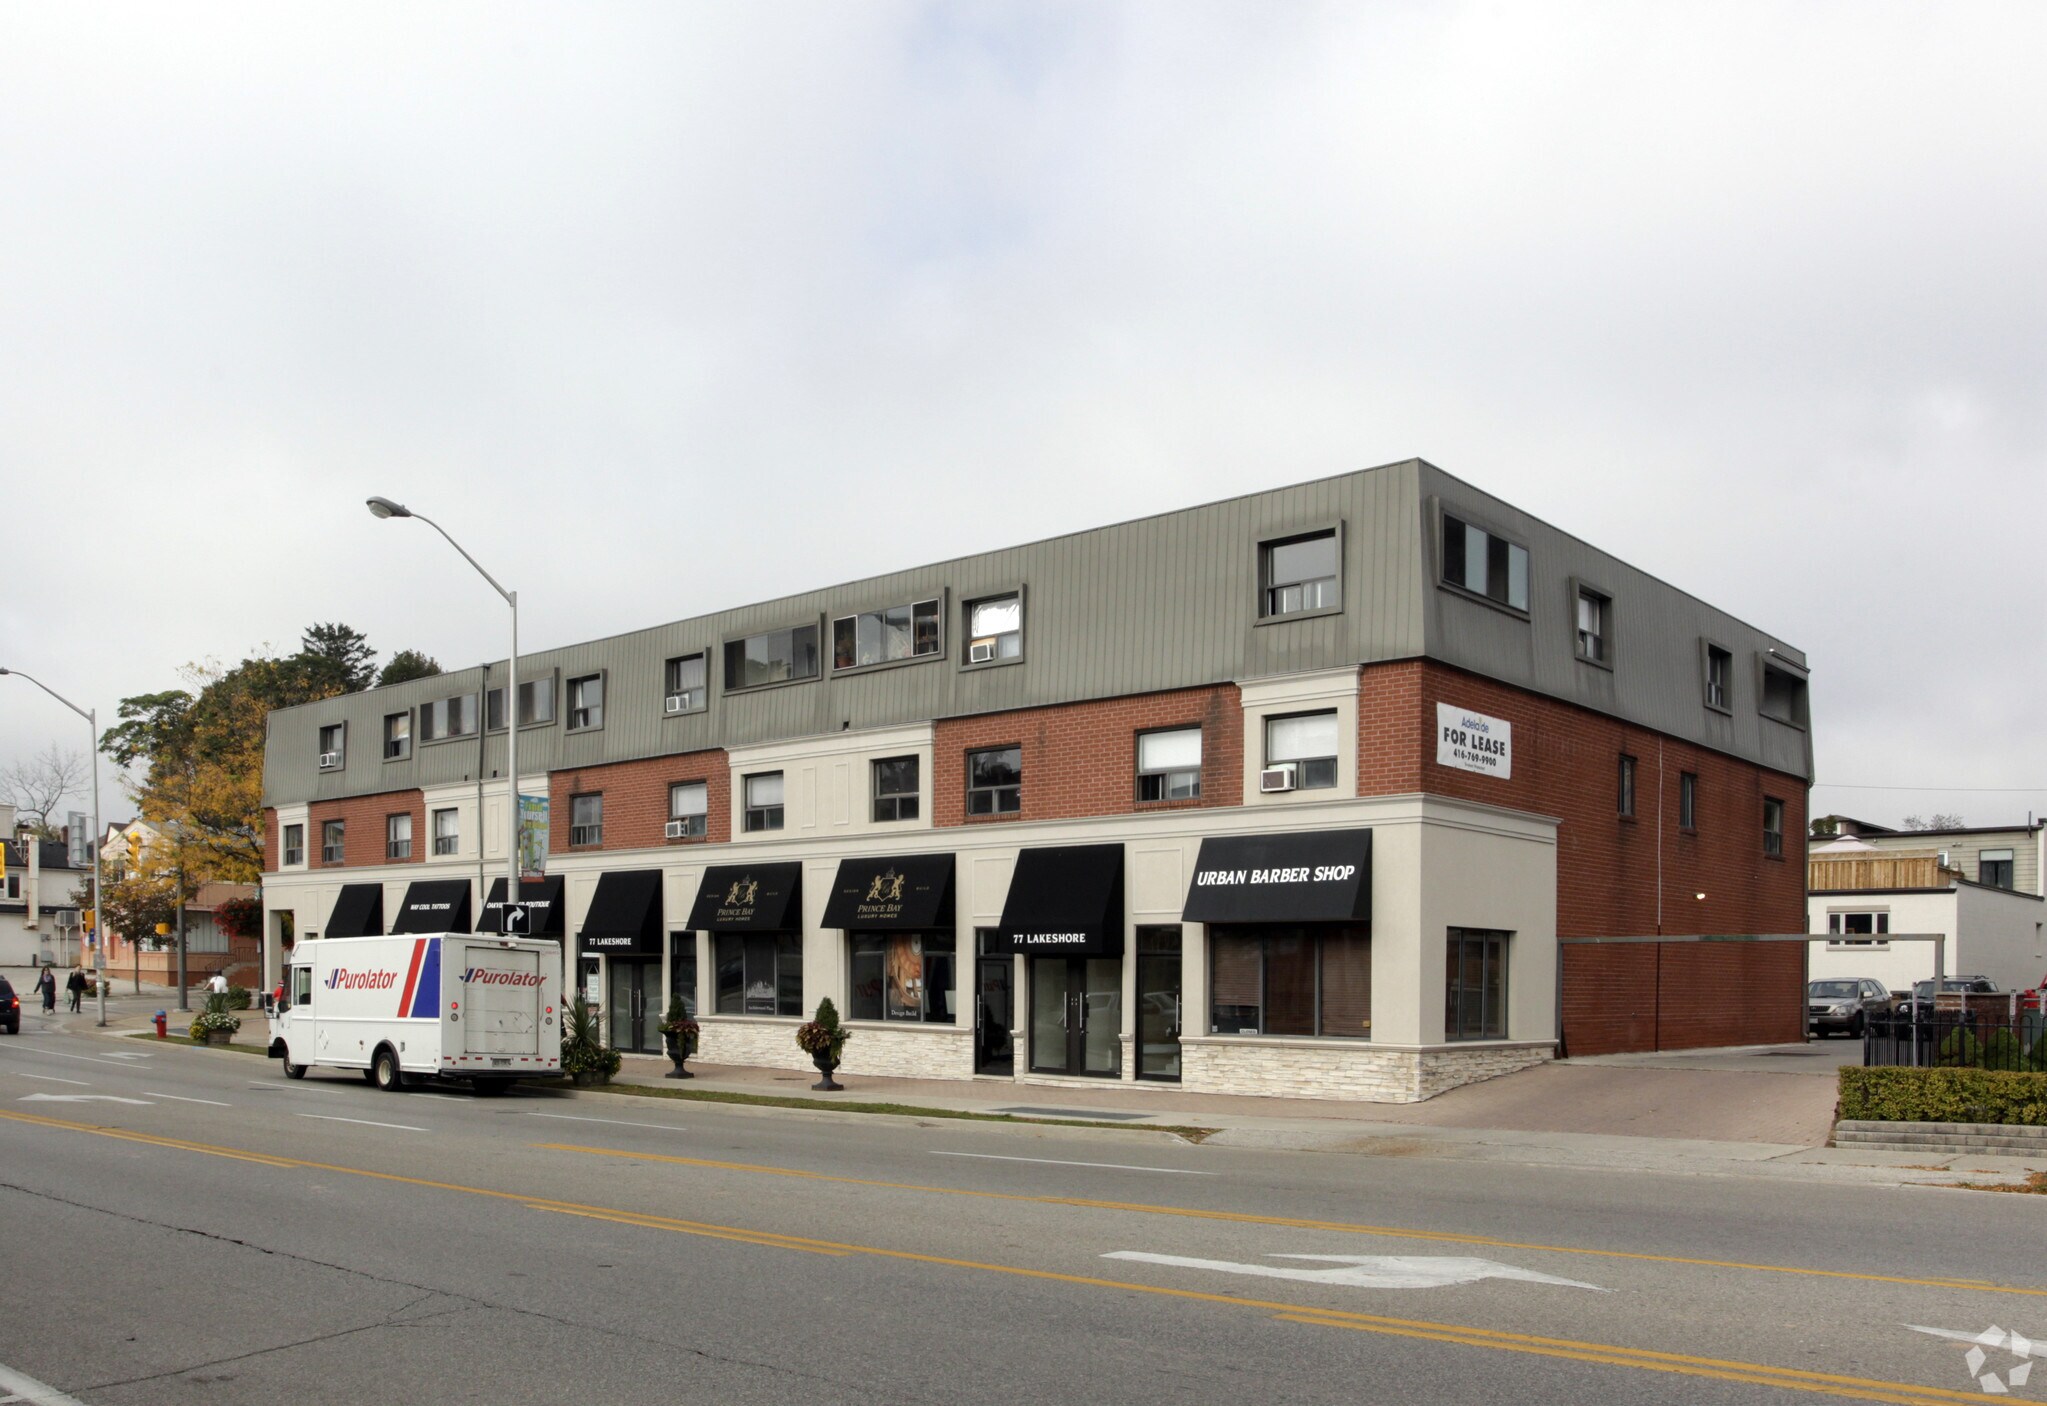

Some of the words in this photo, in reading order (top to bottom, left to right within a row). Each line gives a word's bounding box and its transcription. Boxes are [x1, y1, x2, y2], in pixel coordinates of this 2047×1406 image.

[1443, 726, 1467, 748] FOR
[1471, 733, 1506, 757] LEASE
[1453, 748, 1497, 767] 416-769-9900
[1196, 870, 1247, 886] URBAN
[1250, 867, 1310, 884] BARBER
[1313, 865, 1355, 882] SHOP
[717, 908, 742, 916] PRINCE
[741, 907, 755, 915] BAY
[857, 904, 886, 913] PRINCE
[886, 903, 903, 912] BAY
[589, 938, 596, 946] 77
[597, 937, 632, 946] LAKESHORE
[1013, 934, 1024, 944] 77
[1027, 933, 1086, 944] LAKESHORE
[336, 968, 398, 990] Purolator
[472, 968, 547, 988] Purolator
[905, 1009, 917, 1017] Build
